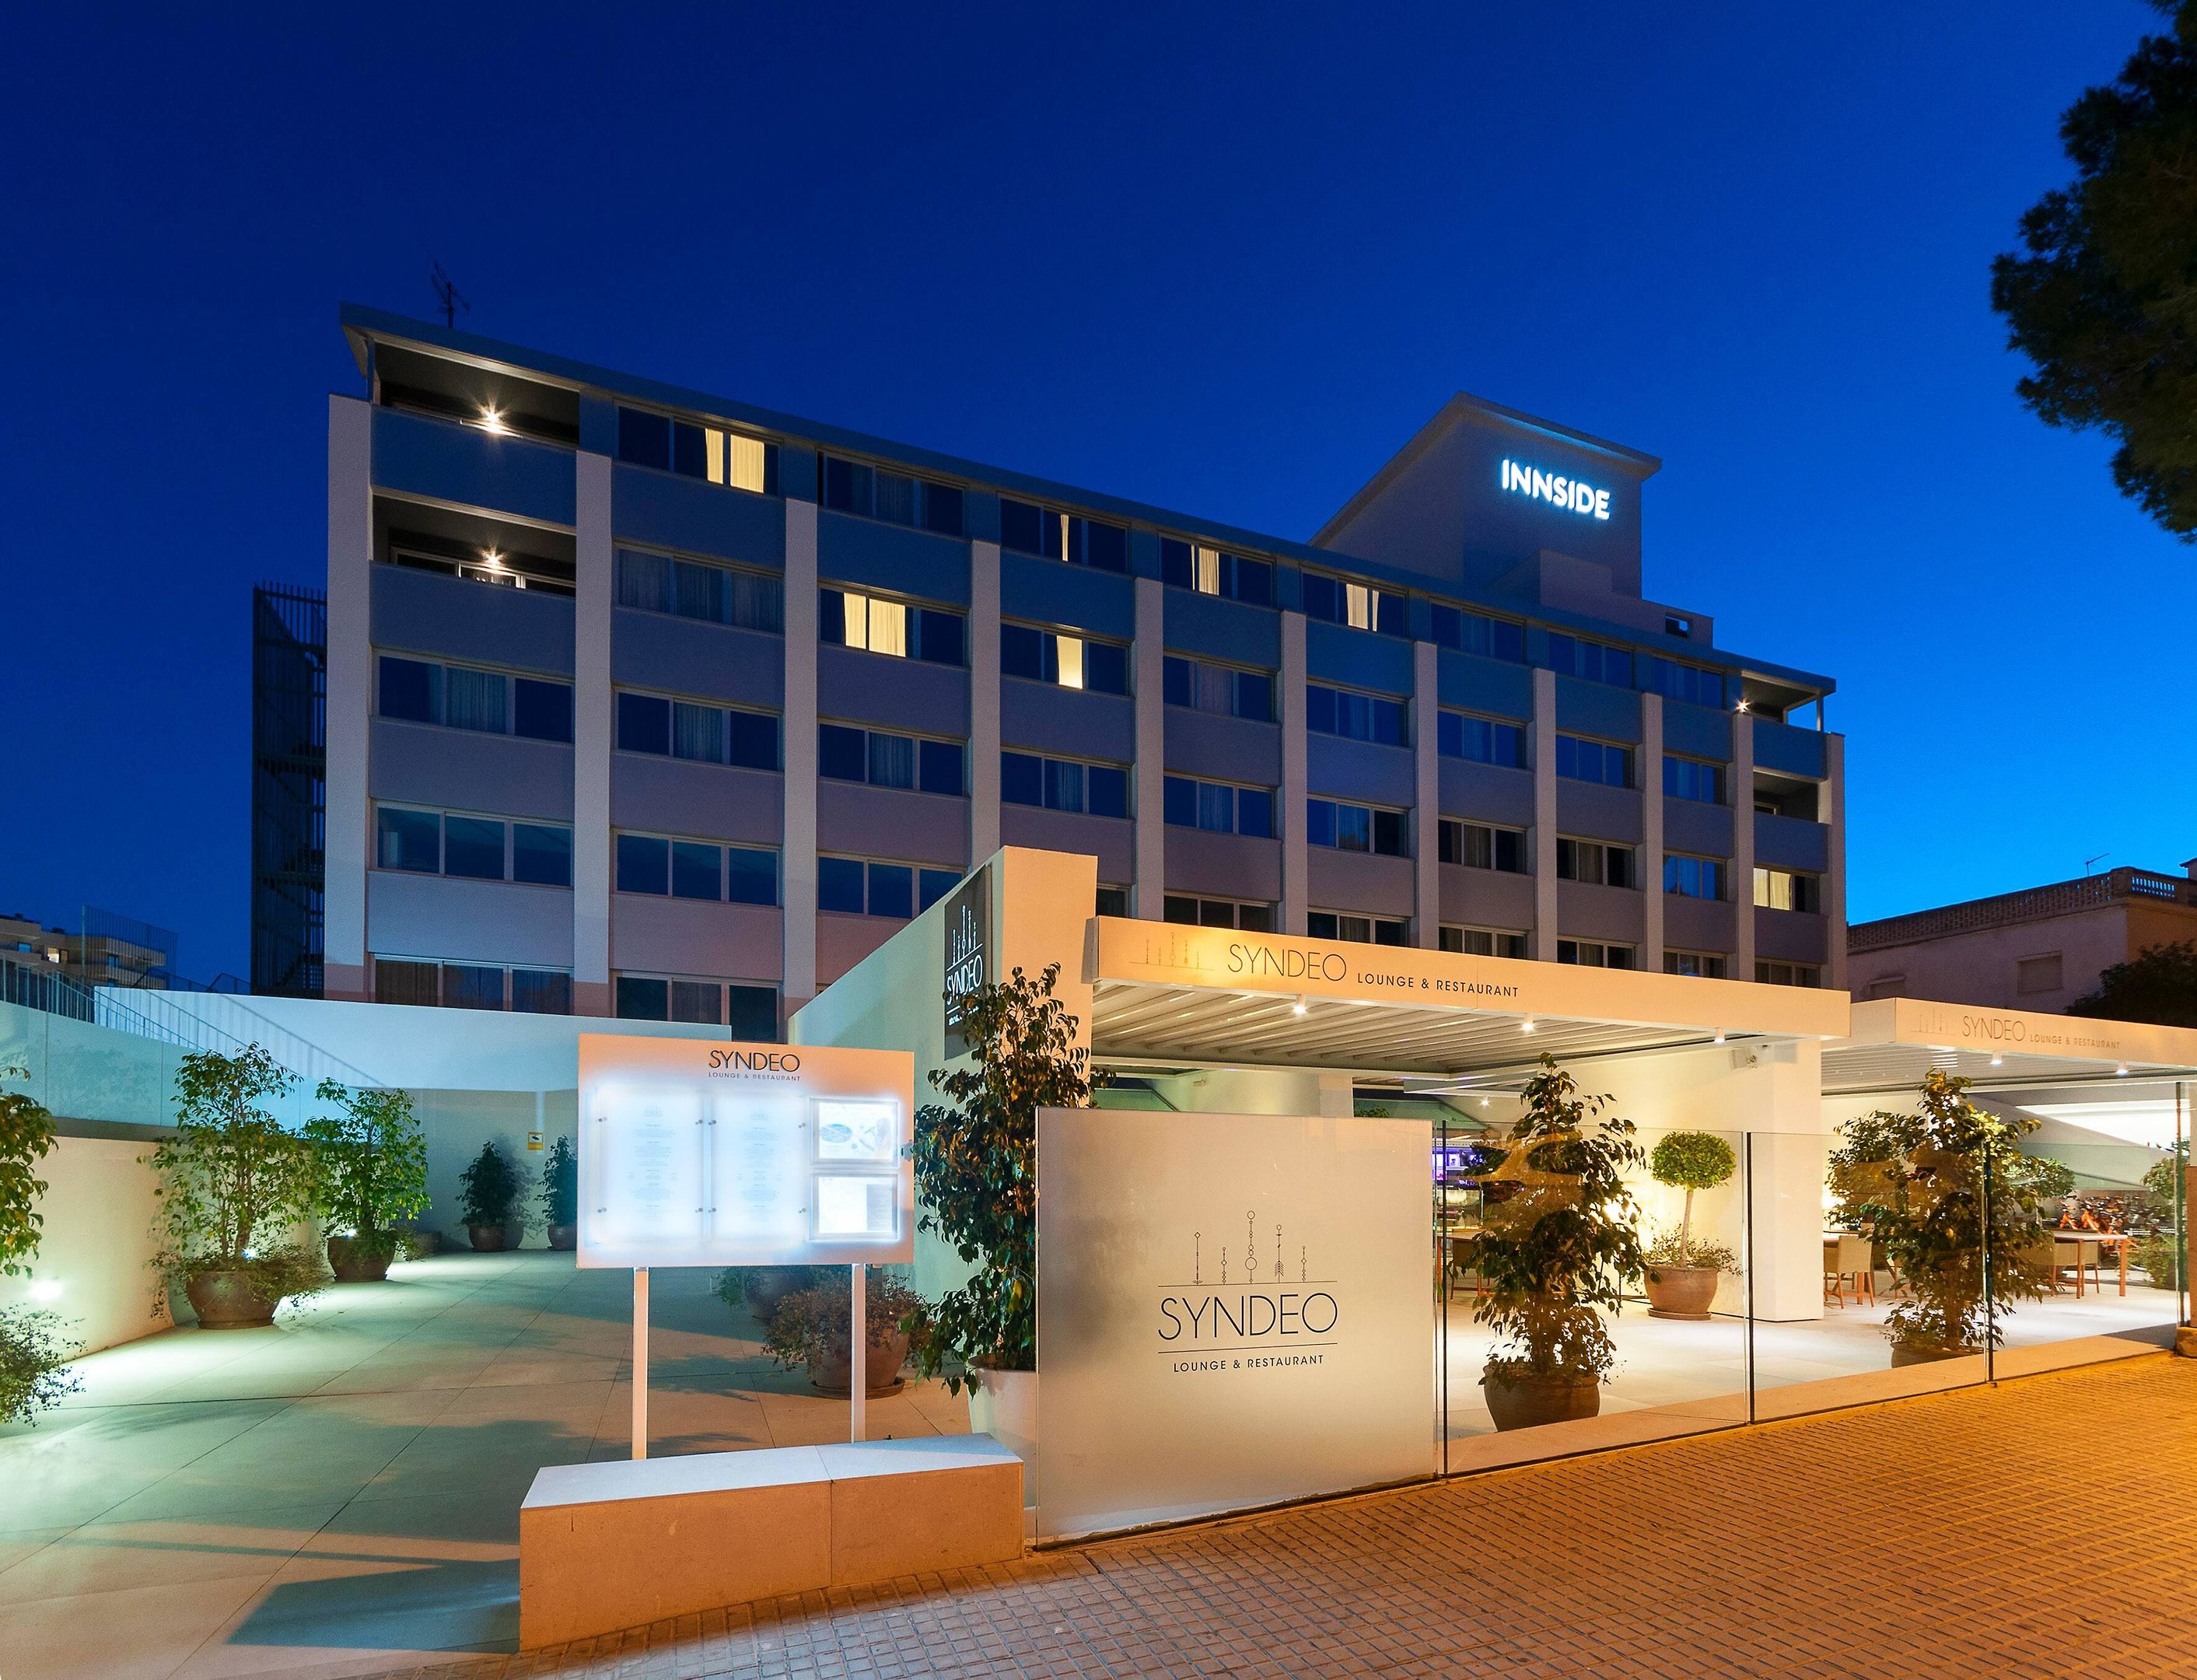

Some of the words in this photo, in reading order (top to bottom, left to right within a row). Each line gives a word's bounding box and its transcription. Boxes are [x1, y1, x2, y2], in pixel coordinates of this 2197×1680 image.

[1502, 459, 1611, 520] INNSIDE
[946, 954, 983, 1005] SYNDEO
[1227, 943, 1347, 982] SYNDEO
[1357, 972, 1415, 989] LOUNGE
[1421, 978, 1430, 989] &
[1436, 979, 1519, 998] RESTAURANT
[1962, 1015, 2026, 1041] SYNDEO
[2030, 1034, 2062, 1045] LOUNGE
[2073, 1038, 2121, 1049] RESTAURANT
[708, 1049, 800, 1073] SYNDEO
[752, 1073, 800, 1082] RESTAURANT
[1157, 1293, 1338, 1340] SYNDEO
[1174, 1360, 1226, 1372] LOUNGE
[1233, 1359, 1241, 1369] &
[1247, 1354, 1324, 1368] RESTAURANT
